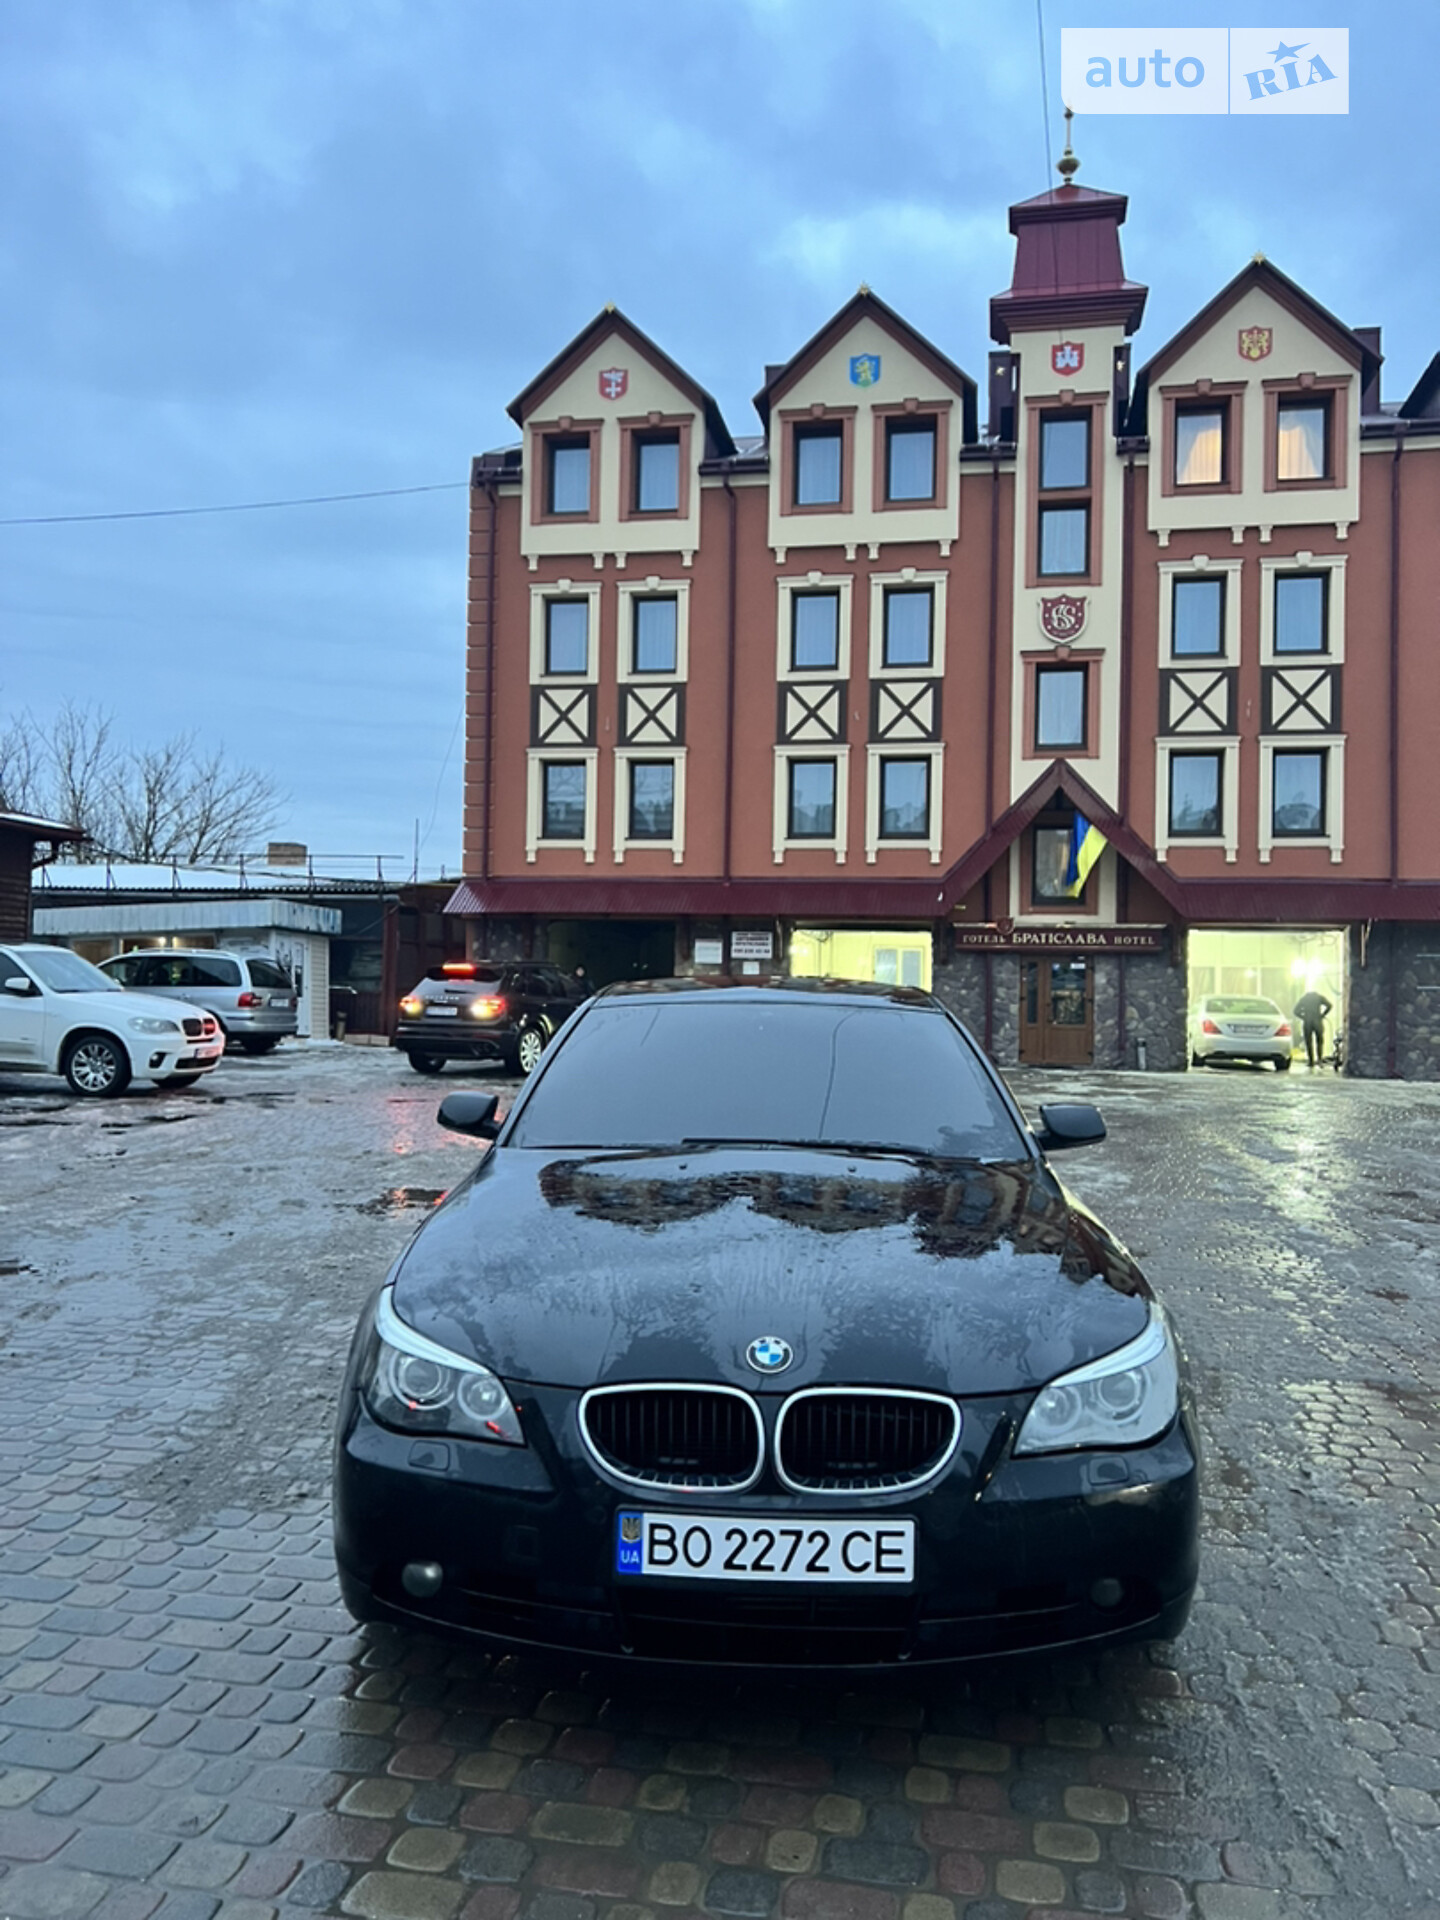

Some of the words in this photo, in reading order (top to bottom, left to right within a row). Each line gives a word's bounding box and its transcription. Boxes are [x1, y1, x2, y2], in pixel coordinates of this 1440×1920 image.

[1113, 935, 1156, 945] HOTEL
[648, 1522, 712, 1568] BO
[722, 1528, 830, 1573] 2272
[841, 1530, 906, 1574] CE
[620, 1550, 640, 1564] UA
